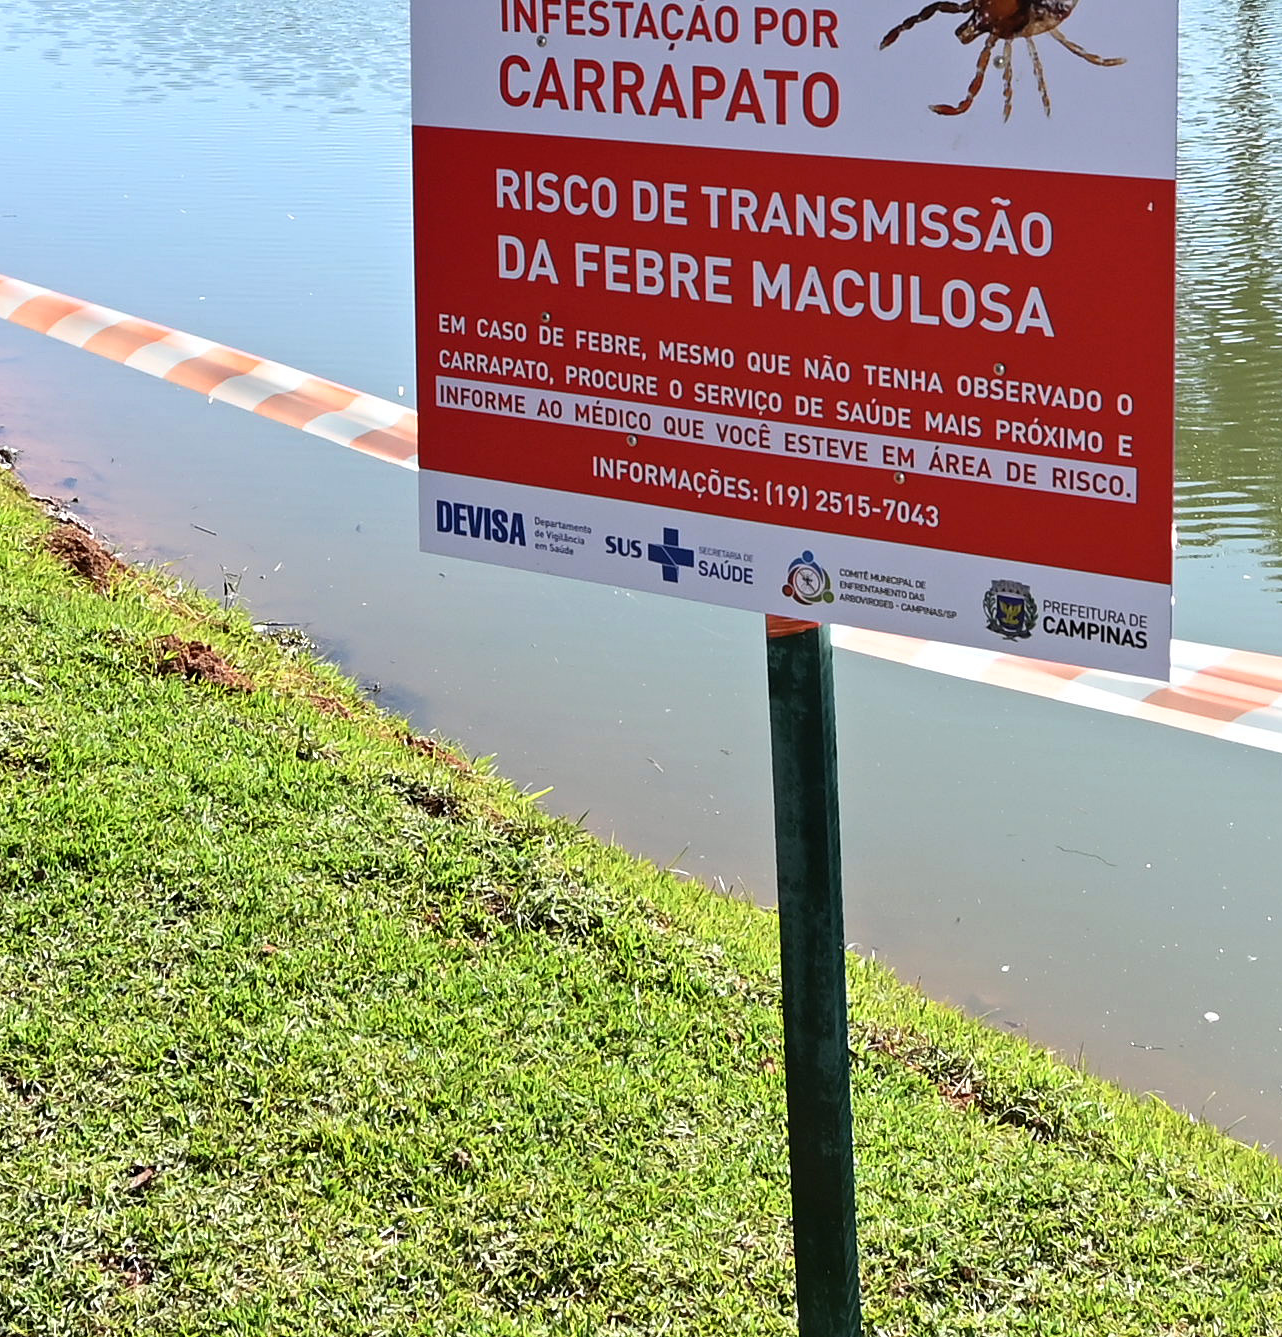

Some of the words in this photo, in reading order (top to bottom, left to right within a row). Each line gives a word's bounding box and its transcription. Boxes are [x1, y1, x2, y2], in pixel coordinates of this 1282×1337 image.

[754, 7, 839, 49] POR
[498, 55, 840, 129] CARRAPATO
[495, 168, 617, 219] RISCO
[633, 180, 688, 226] DE
[701, 186, 1053, 258] TRANSMISSÃO
[498, 235, 559, 285] DA
[575, 243, 732, 304] FEBRE
[753, 263, 1055, 338] MACULOSA
[438, 313, 466, 335] EM
[476, 318, 527, 342] CASO
[539, 324, 564, 347] DE
[576, 330, 647, 361] FEBRE,
[659, 341, 734, 369] MESMO
[747, 351, 791, 376] QUE
[804, 355, 850, 382] NÃO
[863, 364, 943, 394] TENHA
[957, 375, 1102, 413] OBSERVADO
[1117, 393, 1134, 416] O
[438, 349, 554, 385] CARRAPATO,
[565, 365, 658, 396] PROCURE
[669, 378, 682, 400] O
[694, 382, 782, 416] SERVIÇO
[795, 395, 823, 419] DE
[836, 398, 911, 429] SAÚDE
[925, 411, 982, 438] MAIS
[996, 418, 1103, 453] PRÓXIMO
[1118, 435, 1133, 457] E
[440, 384, 526, 414] INFORME
[537, 398, 563, 419] AO
[574, 400, 651, 431] MÉDICO
[663, 416, 704, 440] QUE
[715, 422, 771, 449] VOCÊ
[784, 433, 868, 462] ESTEVE
[882, 444, 915, 468] EM
[928, 446, 992, 479] ÁREA
[1006, 461, 1037, 485] DE
[1052, 467, 1132, 498] RISCO.
[591, 455, 760, 502] INFORMAÇÕES:
[765, 480, 809, 512] (19)
[815, 489, 940, 528] 2515-7043
[436, 499, 526, 547] DEVISA
[534, 516, 592, 534] Departamento
[534, 529, 544, 538] de
[546, 530, 585, 545] Vigilância
[534, 543, 548, 551] em
[549, 544, 574, 555] Saúde
[605, 535, 642, 559] SUS
[698, 546, 742, 560] SECRETARIA
[743, 554, 753, 562] DE
[698, 560, 754, 585] SAÚDE
[839, 568, 868, 581] COMITÊ
[870, 573, 914, 588] MUNICIPAL
[915, 580, 926, 589] DE
[839, 580, 907, 599] ENFRENTAMENTO
[909, 592, 925, 602] DAS
[839, 593, 894, 610] ARBOVIROSES
[901, 603, 957, 619] CAMPINAS/SP
[1043, 599, 1126, 626] PREFEITURA
[1129, 613, 1148, 629] DE
[1043, 616, 1148, 649] CAMPINAS
